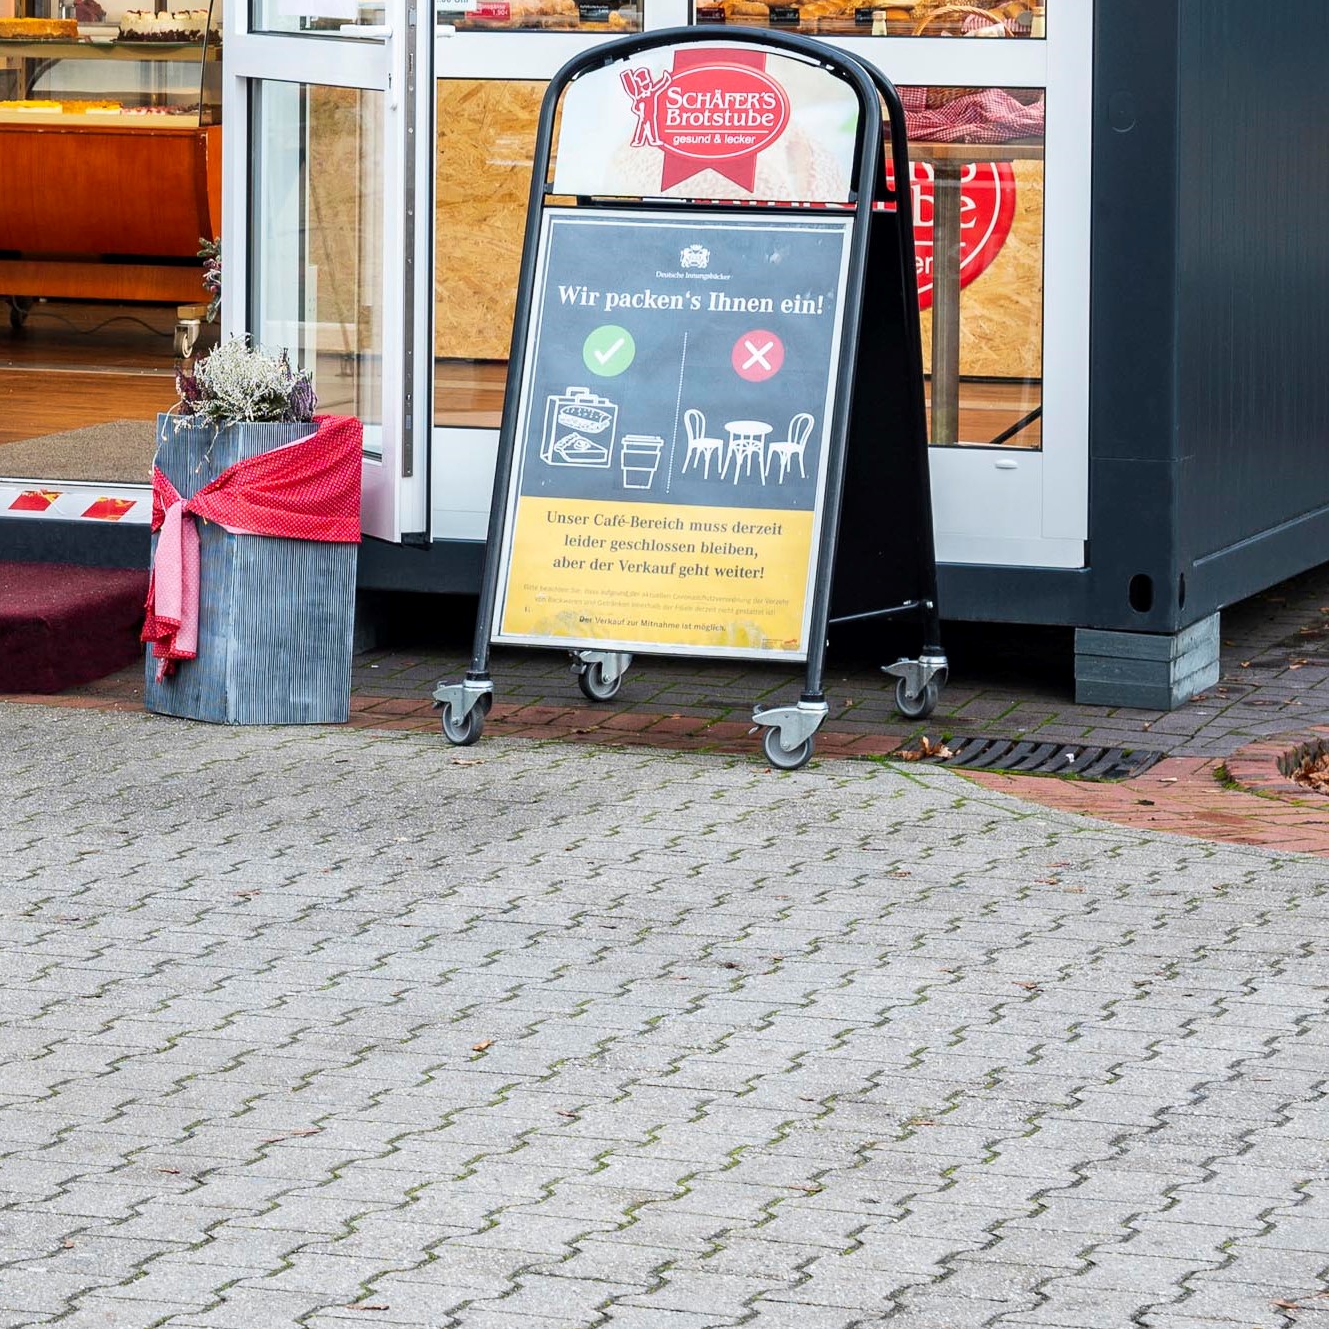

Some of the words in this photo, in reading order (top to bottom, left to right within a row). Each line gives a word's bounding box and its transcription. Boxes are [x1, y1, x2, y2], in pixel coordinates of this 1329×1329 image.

[666, 86, 776, 109] SCHÄFER'S
[666, 108, 775, 127] Brotstube
[673, 134, 711, 146] gesund
[714, 134, 722, 144] &
[724, 134, 756, 144] lecker
[655, 271, 684, 279] Deutsche
[558, 285, 600, 307] Wir
[708, 292, 774, 313] Ihnen
[780, 295, 824, 315] ein!
[546, 511, 589, 526] Unser
[593, 513, 685, 531] Café-Bereich
[689, 521, 727, 533] muss
[731, 520, 783, 536] derzeit
[564, 534, 607, 549] leider
[609, 536, 695, 555] geschlossen
[700, 540, 759, 559] bleiben,
[552, 556, 586, 570] aber
[589, 557, 614, 571] der
[618, 559, 675, 576] Verkauf
[678, 564, 710, 579] geht
[714, 565, 765, 579] weiter!
[579, 615, 593, 624] Der
[595, 616, 625, 625] Verkauf
[640, 619, 680, 629] Mitnahme
[693, 624, 726, 632] möglich.
